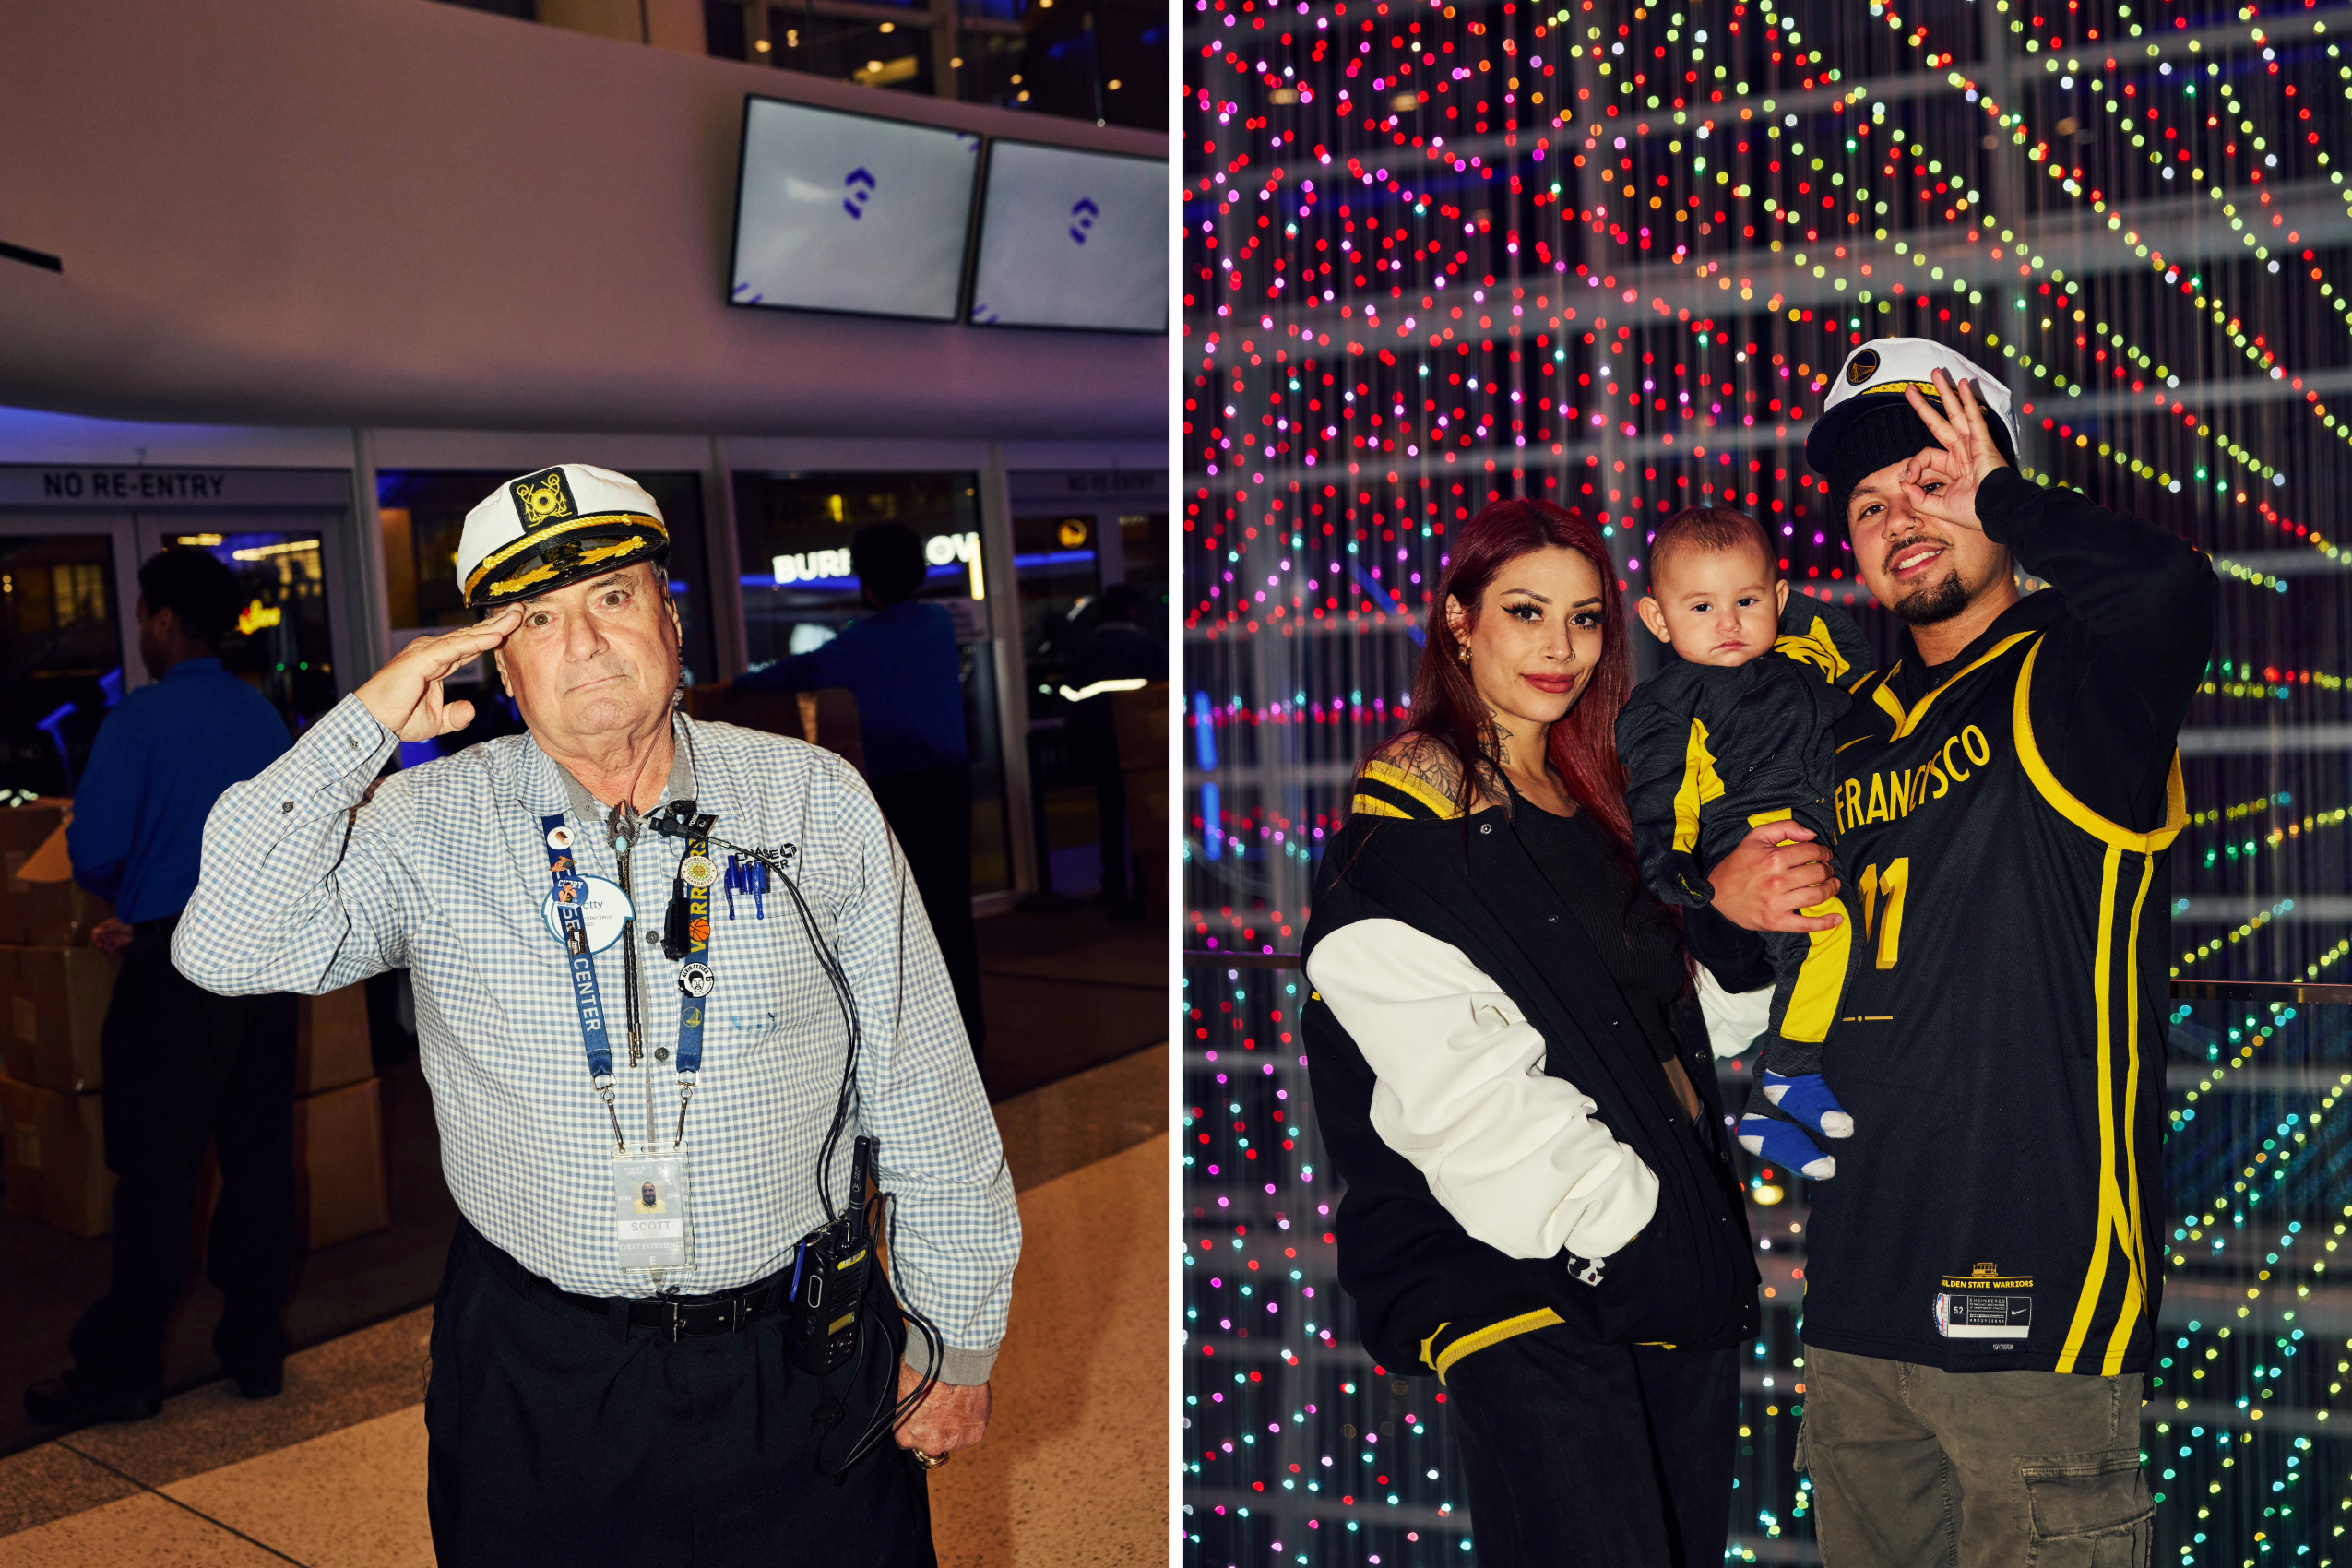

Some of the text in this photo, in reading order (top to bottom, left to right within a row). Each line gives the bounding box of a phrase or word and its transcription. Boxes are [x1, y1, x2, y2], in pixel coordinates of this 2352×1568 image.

[42, 471, 226, 499] NO RE-ENTRY
[1835, 724, 1990, 836] FRANCISCO
[688, 813, 699, 827] YOND
[689, 838, 707, 954] WRRRS
[583, 900, 603, 910] otty
[1859, 857, 1909, 970] 11
[573, 957, 602, 1033] CENTER
[631, 1220, 671, 1232] SCOTT
[619, 1241, 684, 1251] EVENT EXPERIENCE
[649, 1256, 656, 1265] E
[1942, 1279, 1966, 1289] OLDEN
[1993, 1280, 2034, 1289] WARRIORS
[1954, 1306, 1964, 1314] 52
